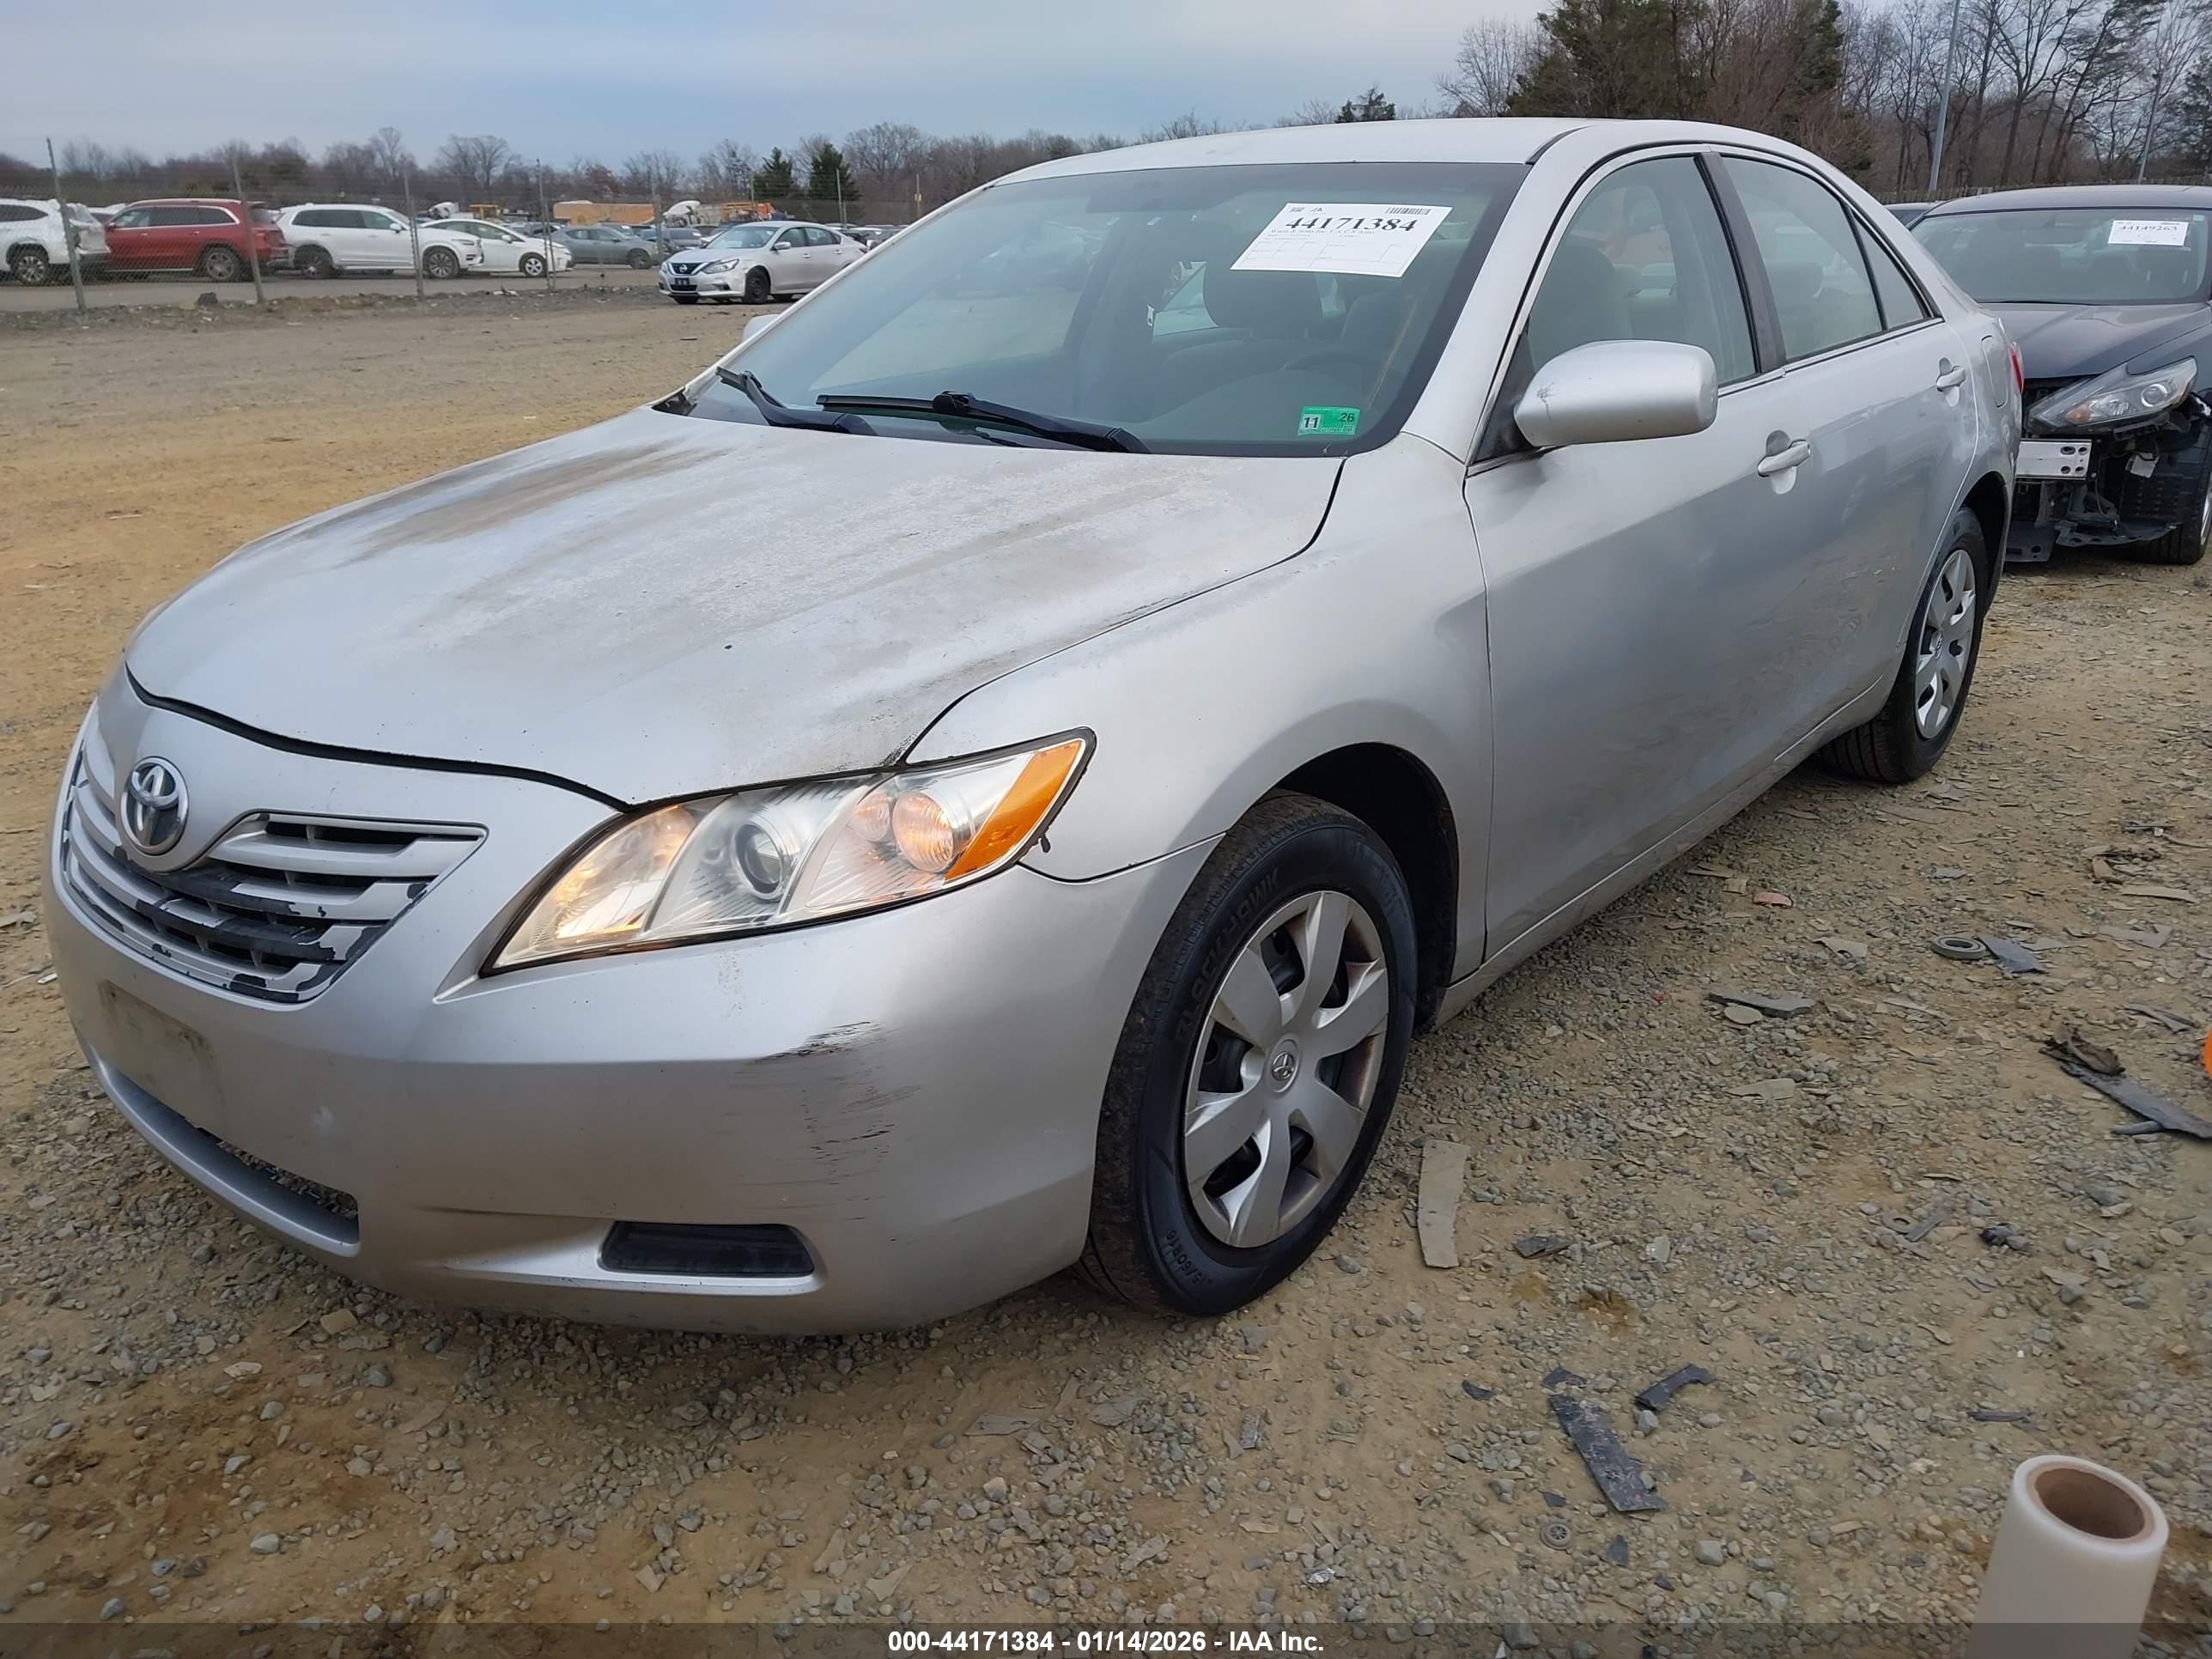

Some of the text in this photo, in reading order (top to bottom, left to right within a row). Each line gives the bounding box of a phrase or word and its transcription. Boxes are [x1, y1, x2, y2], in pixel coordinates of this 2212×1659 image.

[1285, 216, 1419, 232] 44171384
[1304, 416, 1320, 428] 11
[1339, 412, 1356, 422] 26
